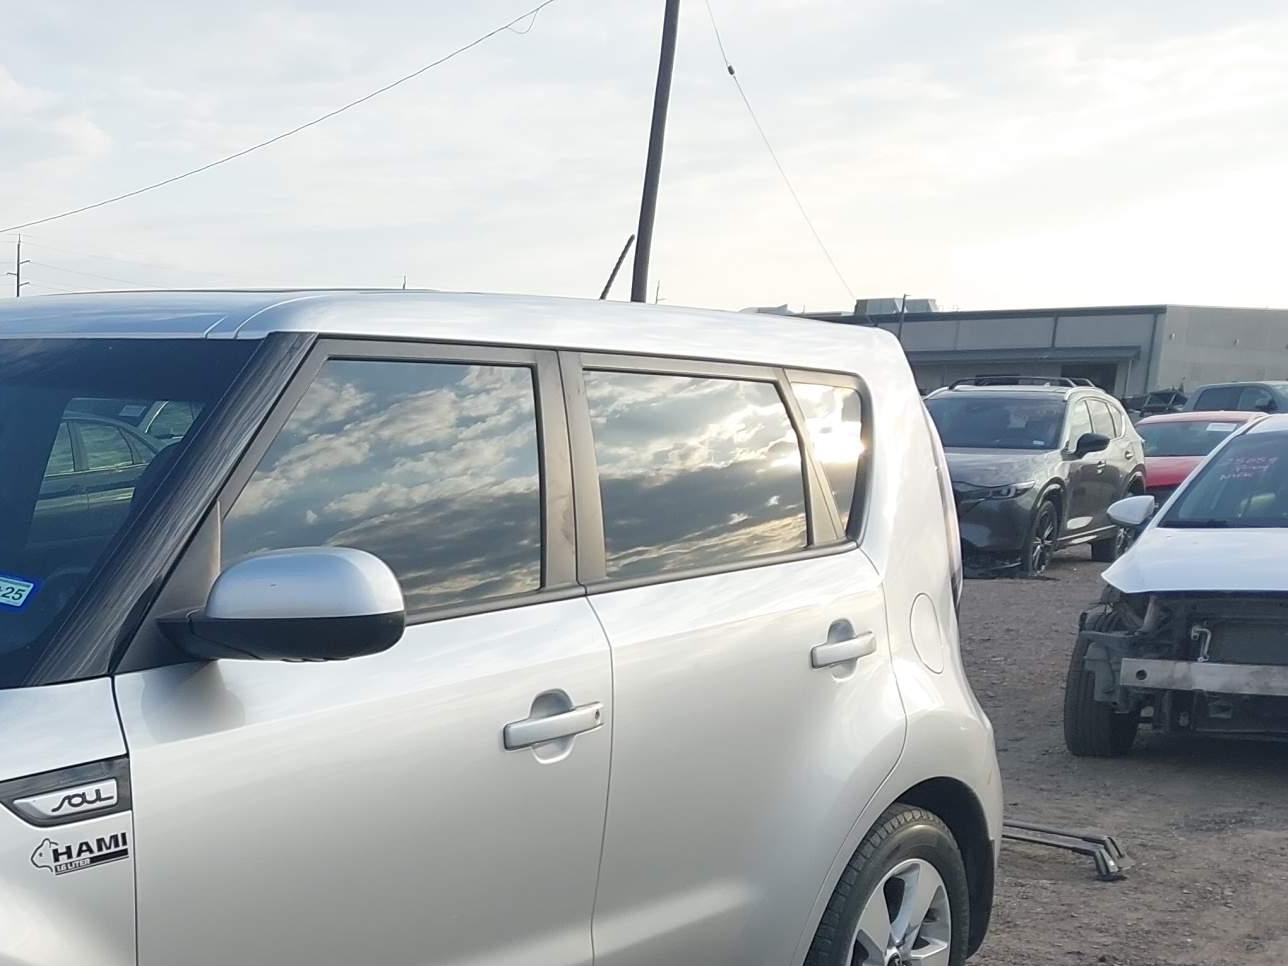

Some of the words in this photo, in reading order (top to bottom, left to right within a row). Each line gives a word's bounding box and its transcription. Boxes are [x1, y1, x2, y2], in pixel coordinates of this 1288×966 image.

[0, 586, 26, 601] 25
[51, 788, 114, 813] SOUL
[53, 831, 128, 863] HAMI
